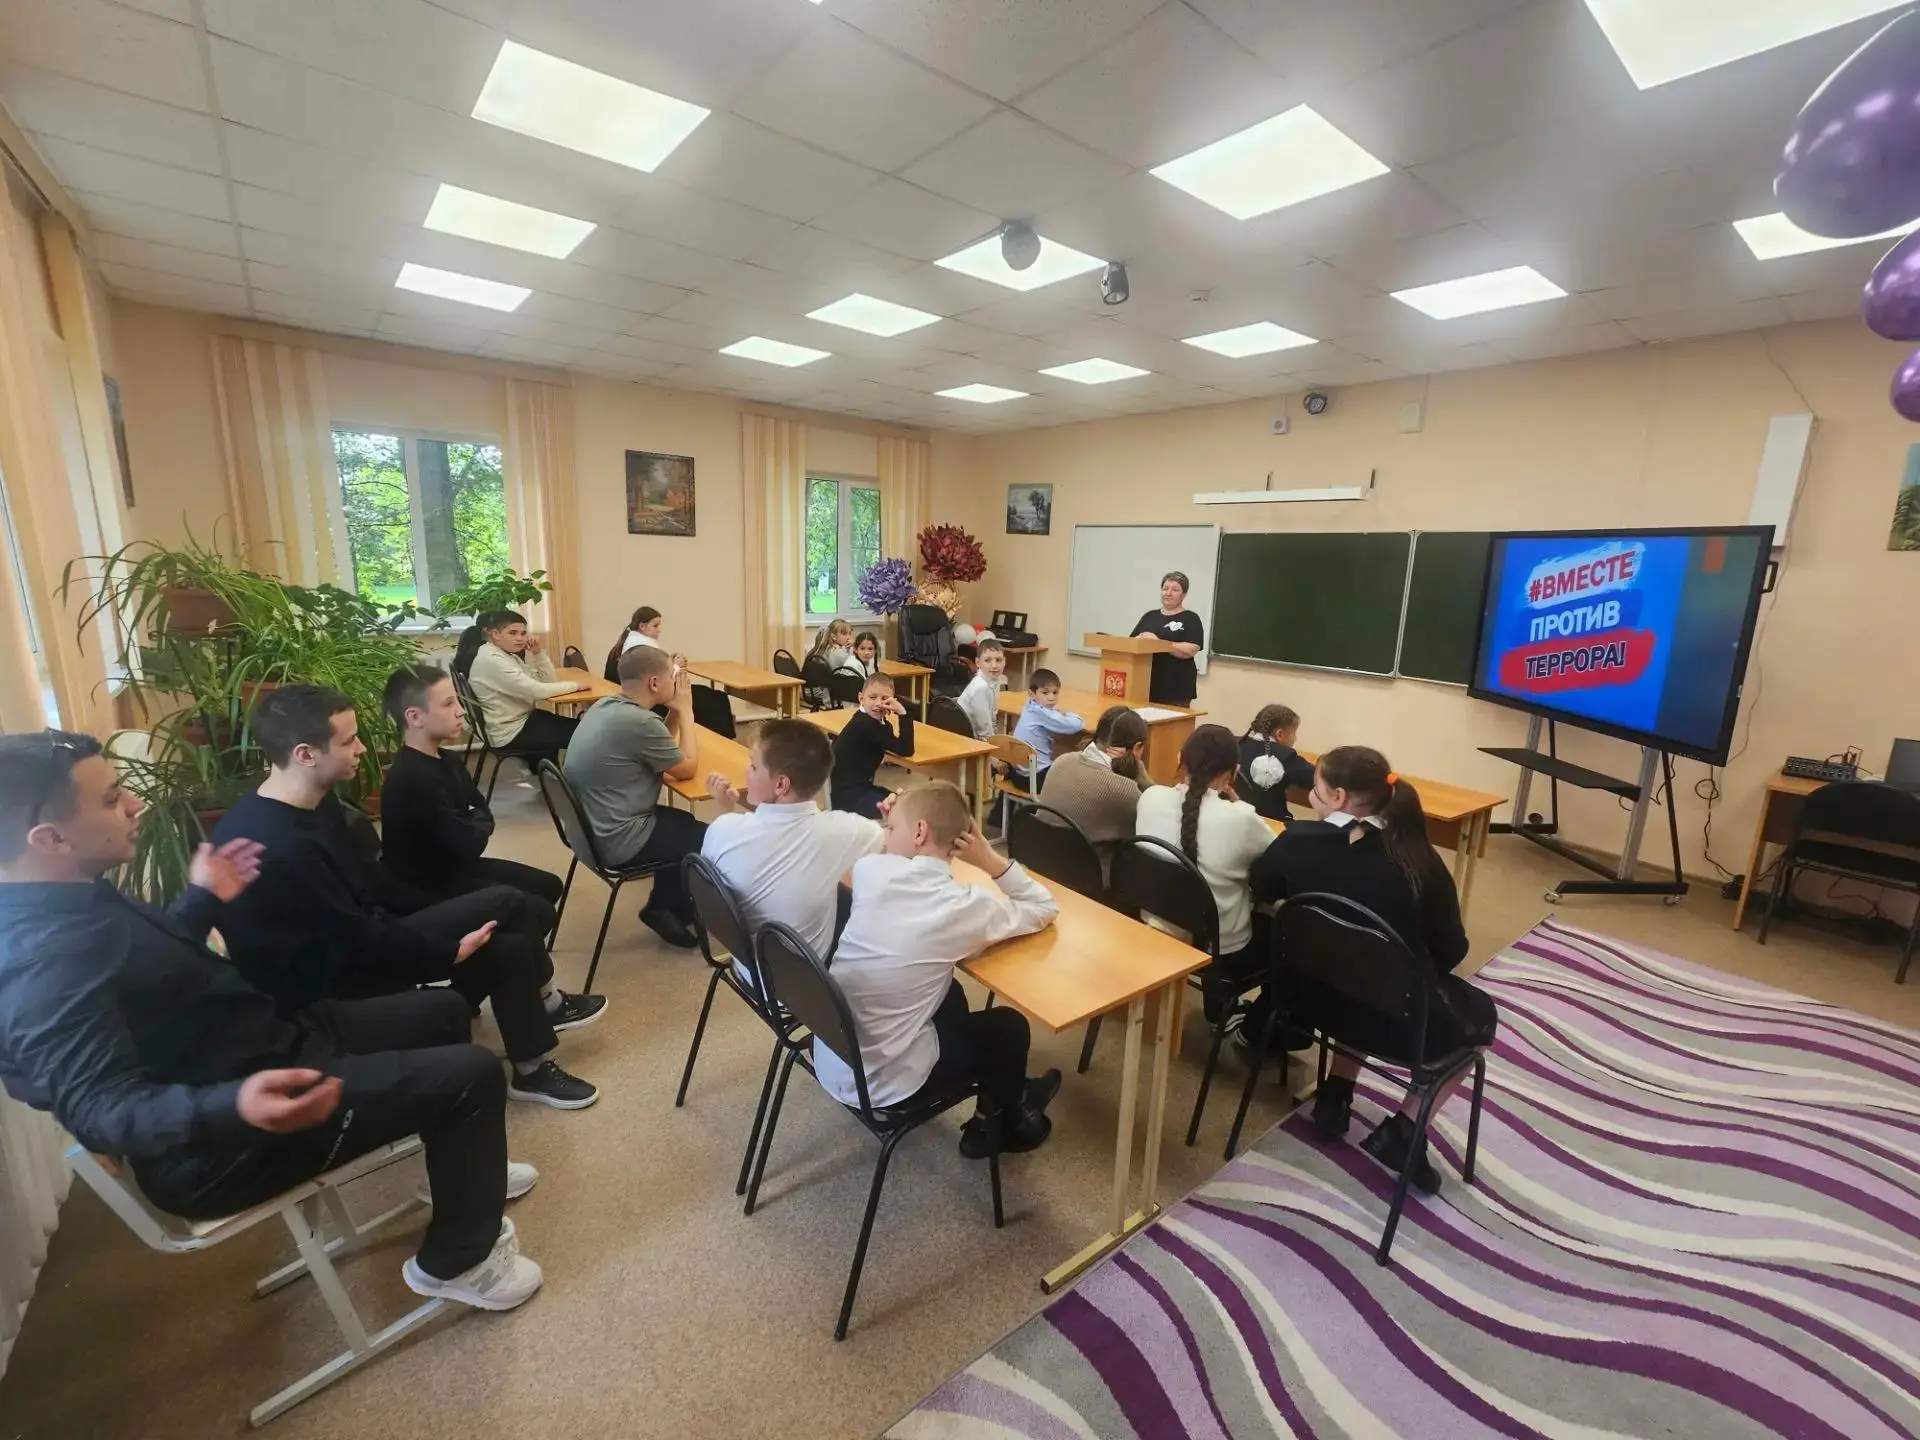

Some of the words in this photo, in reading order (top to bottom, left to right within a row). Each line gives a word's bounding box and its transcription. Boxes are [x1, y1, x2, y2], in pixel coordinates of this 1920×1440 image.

[1529, 551, 1635, 602] #ВМЕСТЕ
[1530, 600, 1621, 641] ПРОТИВ
[1525, 641, 1627, 679] ТЕРРОРА!
